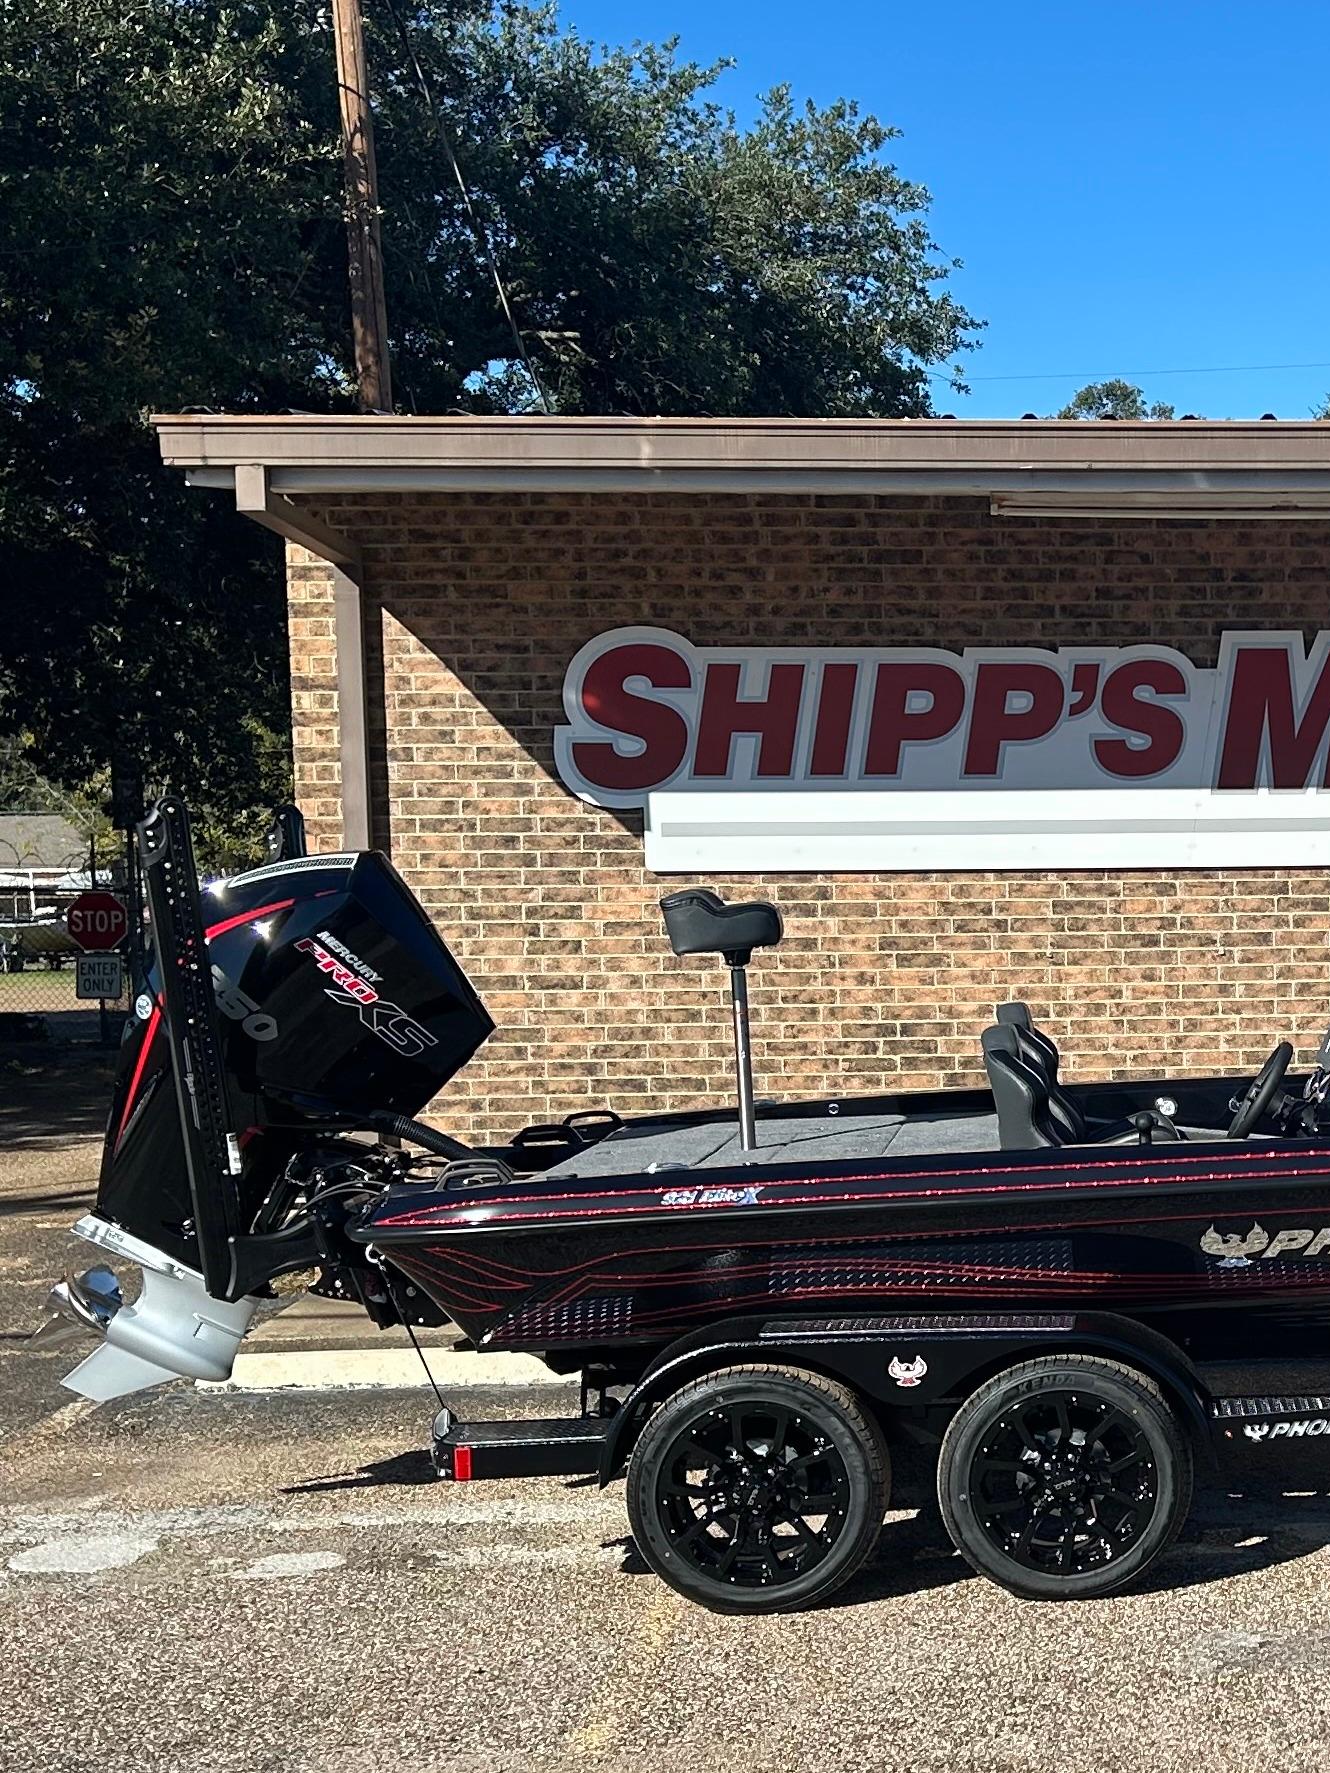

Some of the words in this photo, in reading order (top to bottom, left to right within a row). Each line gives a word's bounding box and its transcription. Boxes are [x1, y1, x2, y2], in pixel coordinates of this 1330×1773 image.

[571, 643, 1187, 790] SHIPP'S
[71, 910, 124, 933] STOP
[80, 962, 118, 976] ENTER
[293, 937, 379, 1005] PRO
[316, 930, 385, 983] MERCURY
[83, 978, 115, 993] ONLY
[323, 988, 439, 1057] XS
[1018, 1375, 1077, 1392] KENDA
